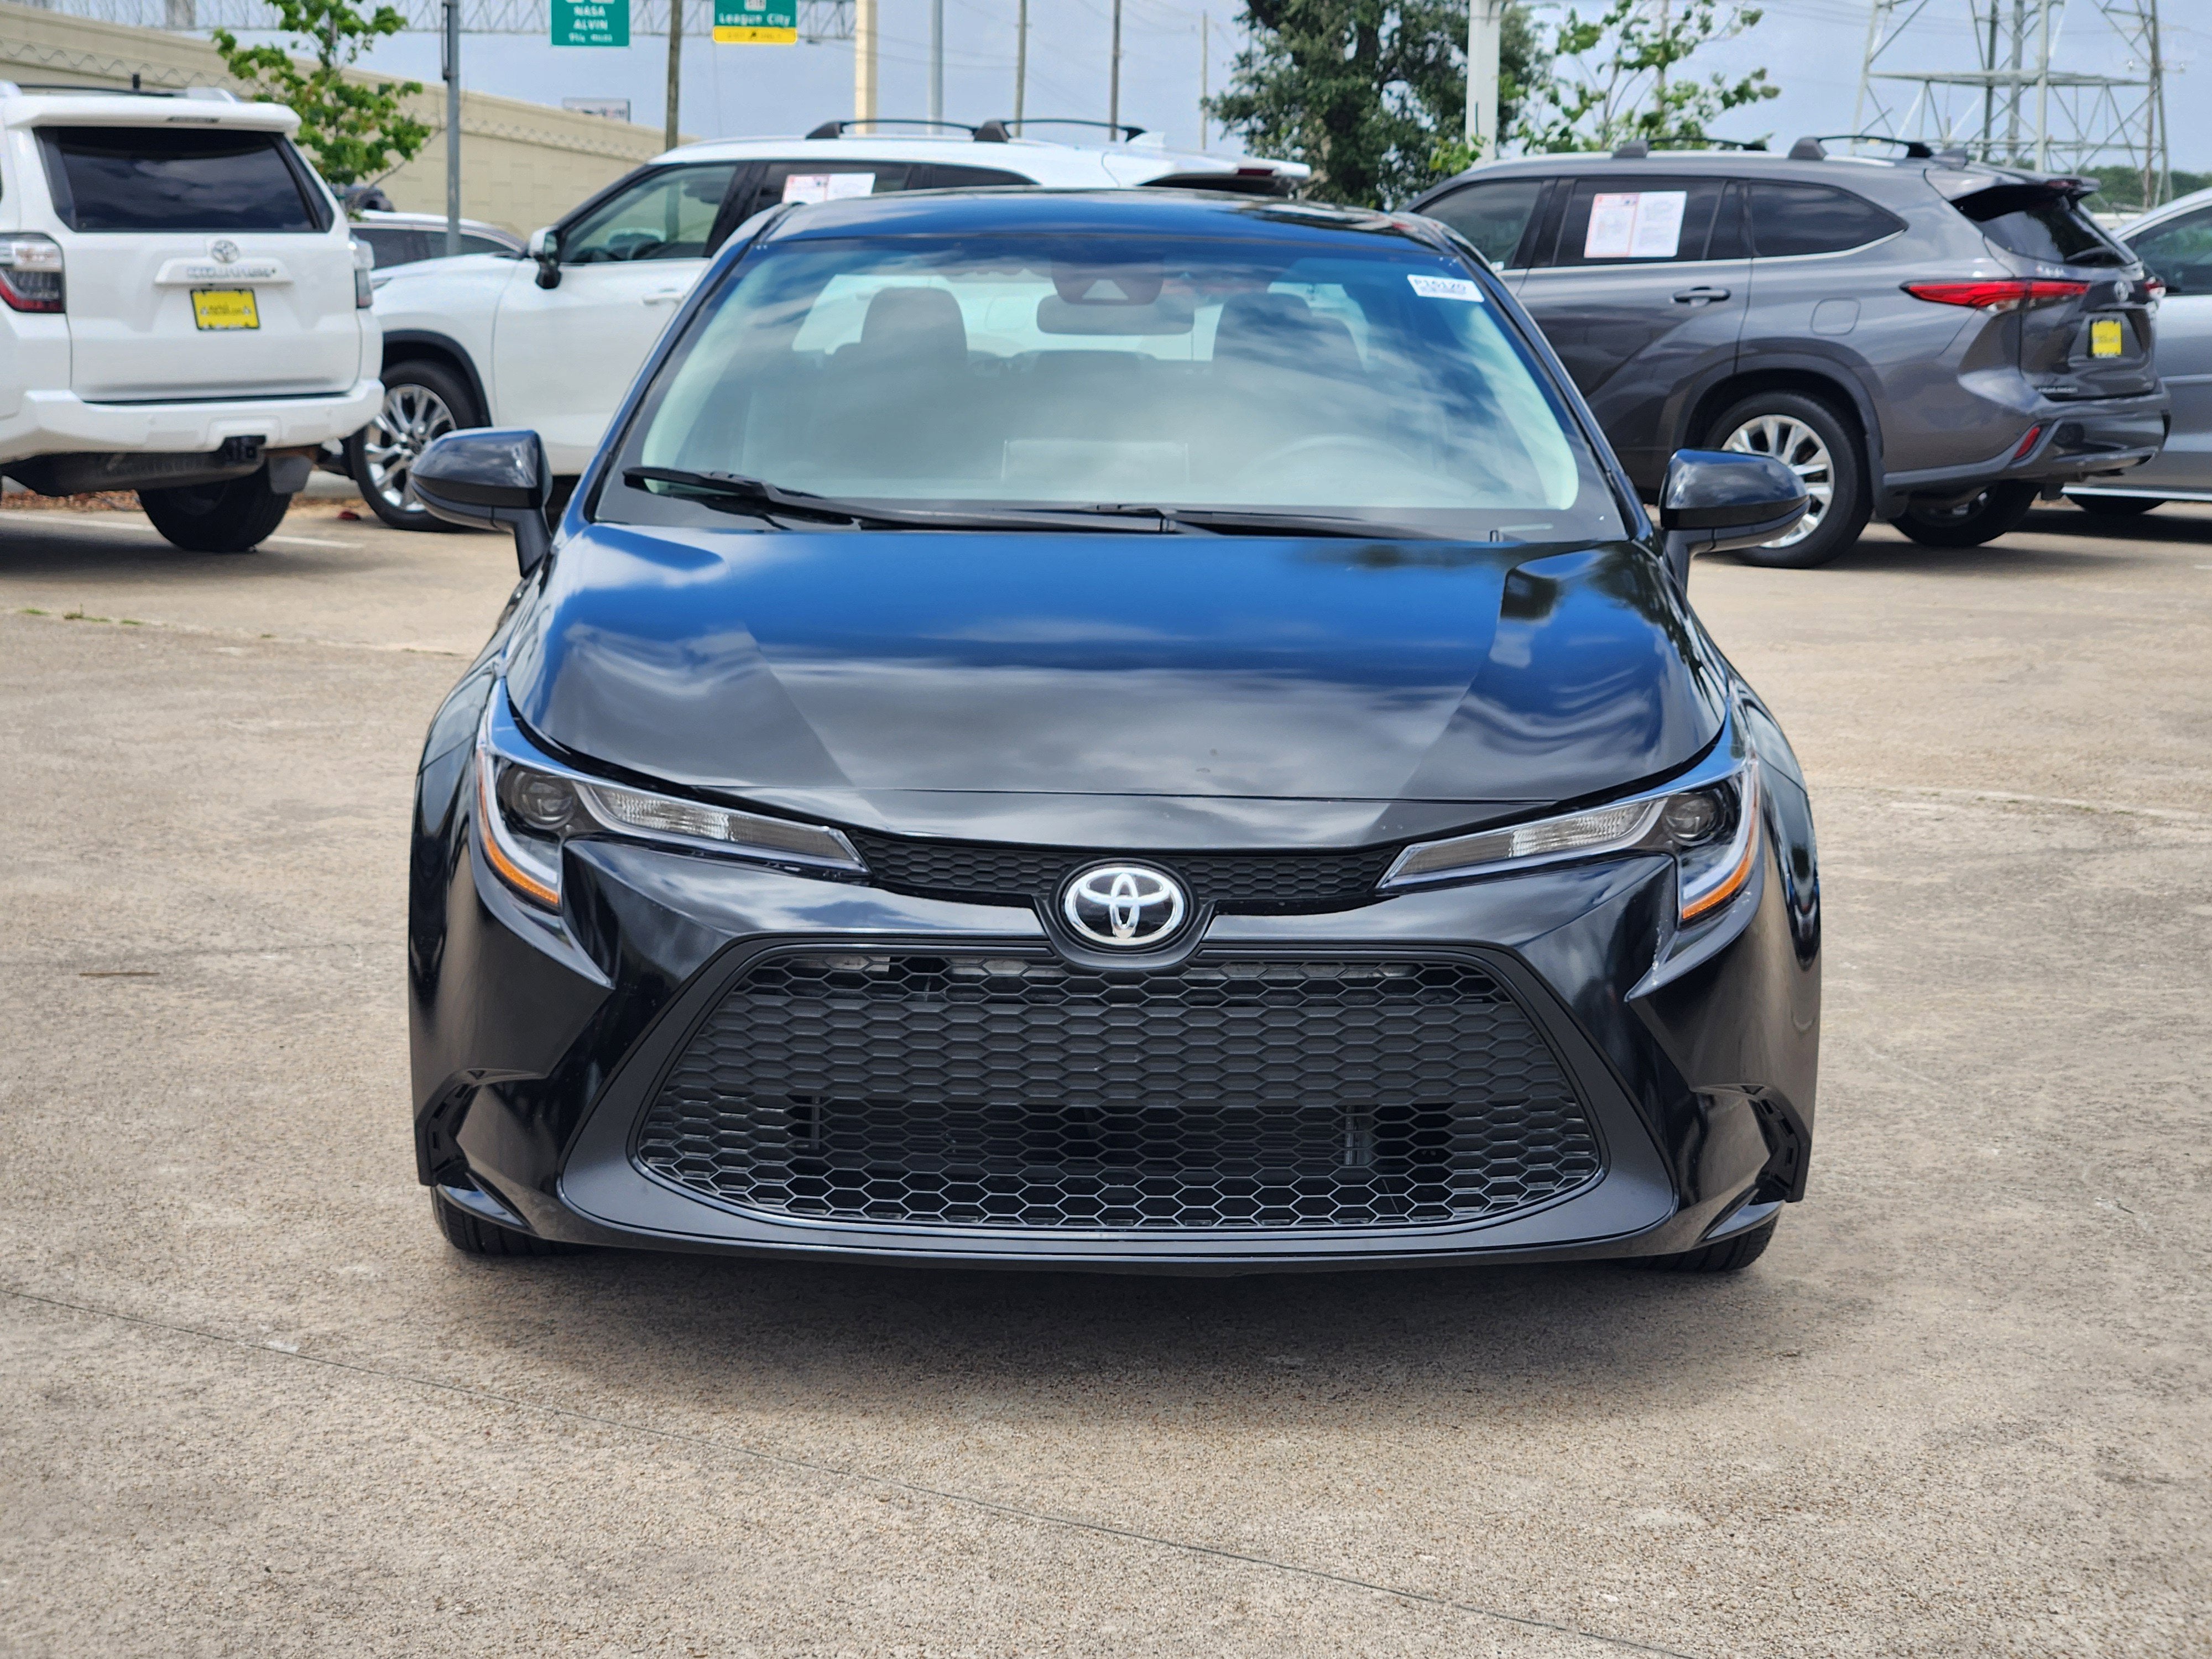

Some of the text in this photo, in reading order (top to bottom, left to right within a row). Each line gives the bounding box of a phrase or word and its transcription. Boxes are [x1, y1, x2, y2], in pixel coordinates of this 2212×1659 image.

[573, 5, 606, 17] NASA
[573, 19, 608, 30] ALVIN
[719, 13, 791, 27] League City
